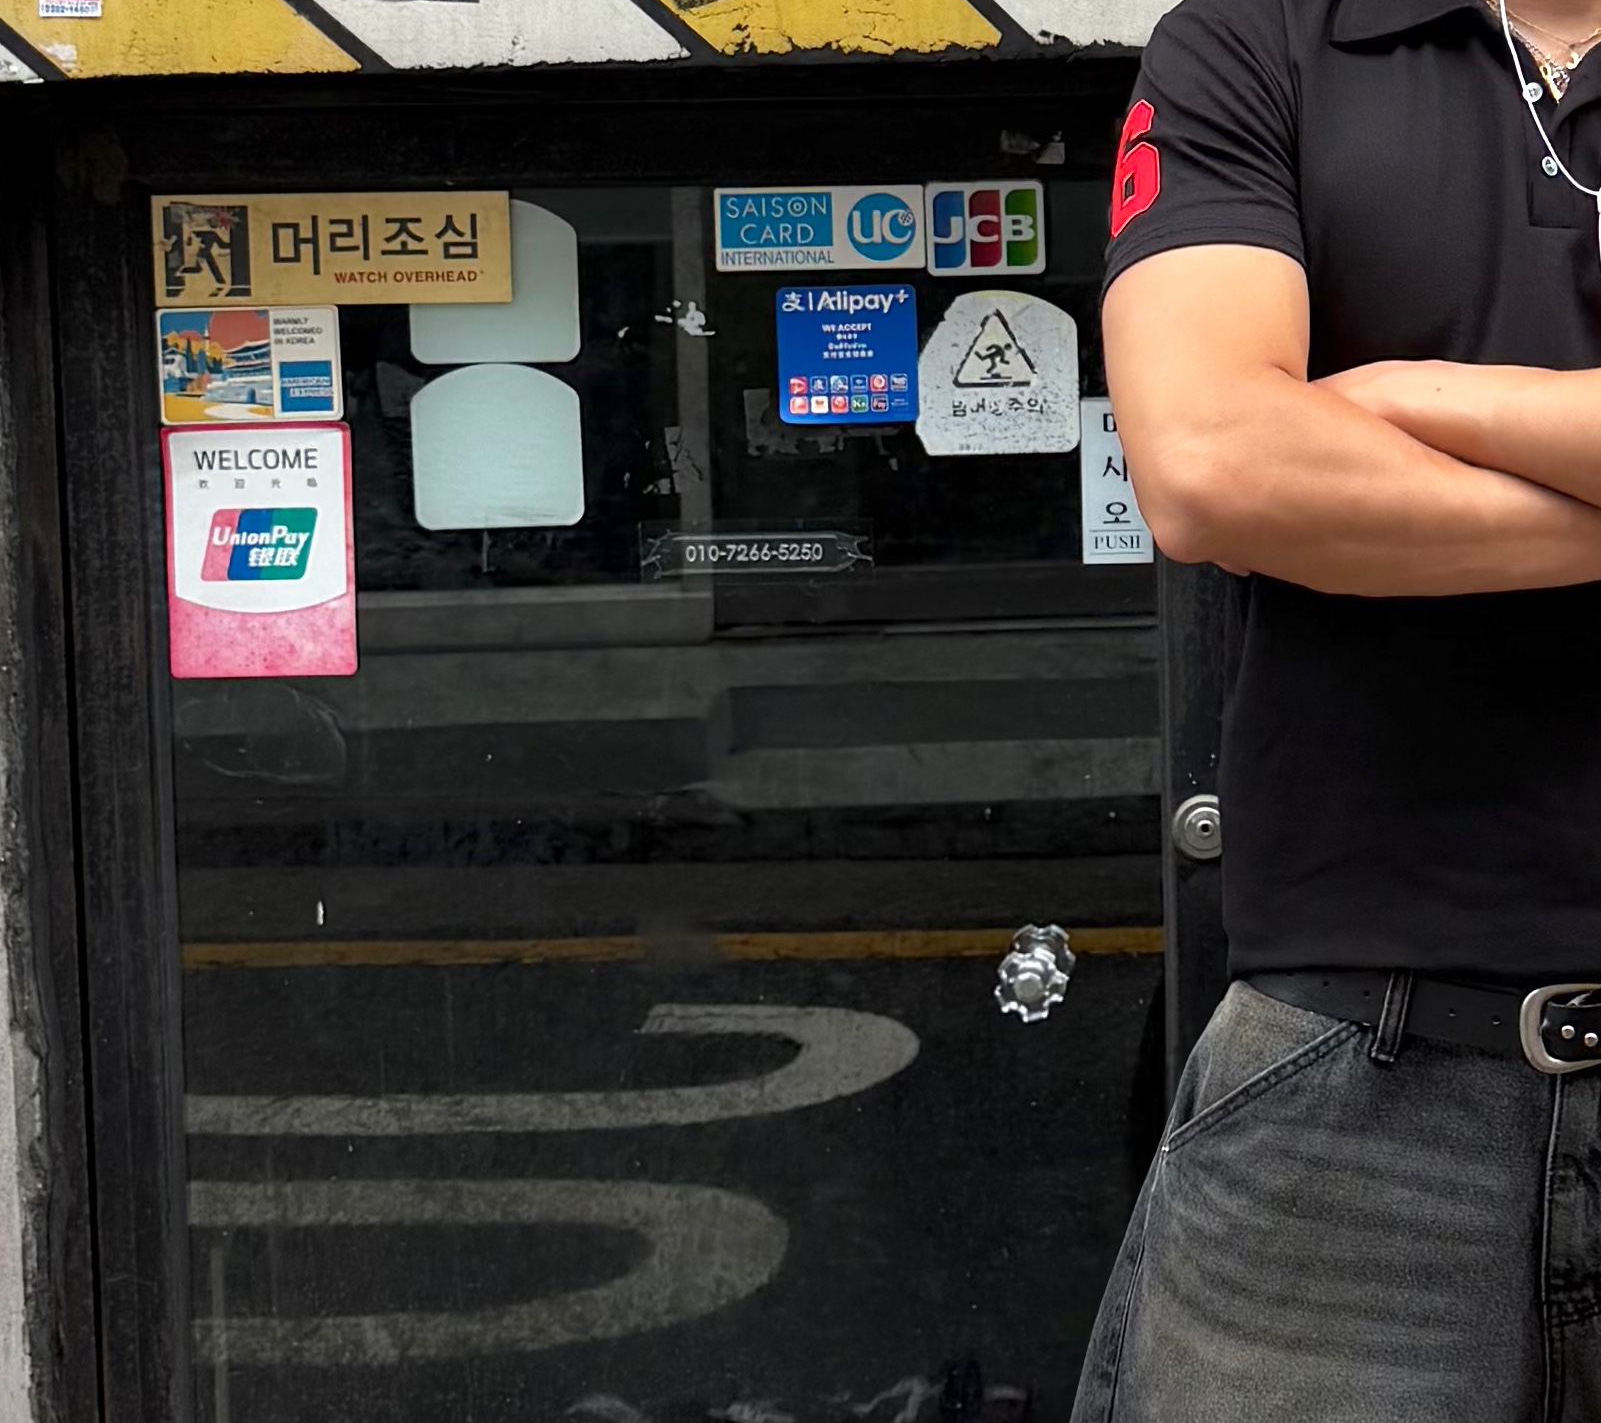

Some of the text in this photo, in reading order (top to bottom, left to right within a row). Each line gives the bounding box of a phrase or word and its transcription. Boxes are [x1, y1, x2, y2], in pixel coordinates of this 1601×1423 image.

[726, 195, 828, 219] SAISON
[739, 223, 814, 246] CARD
[933, 214, 1036, 244] JCB
[271, 213, 480, 276] 머리조심
[720, 248, 835, 266] INTERNATIONAL
[334, 269, 479, 285] WATCH OVERHEAD
[194, 447, 319, 471] WELCOME
[212, 524, 311, 555] UnionPay
[1094, 534, 1142, 550] PUSH
[685, 544, 824, 562] 010-7266-5250
